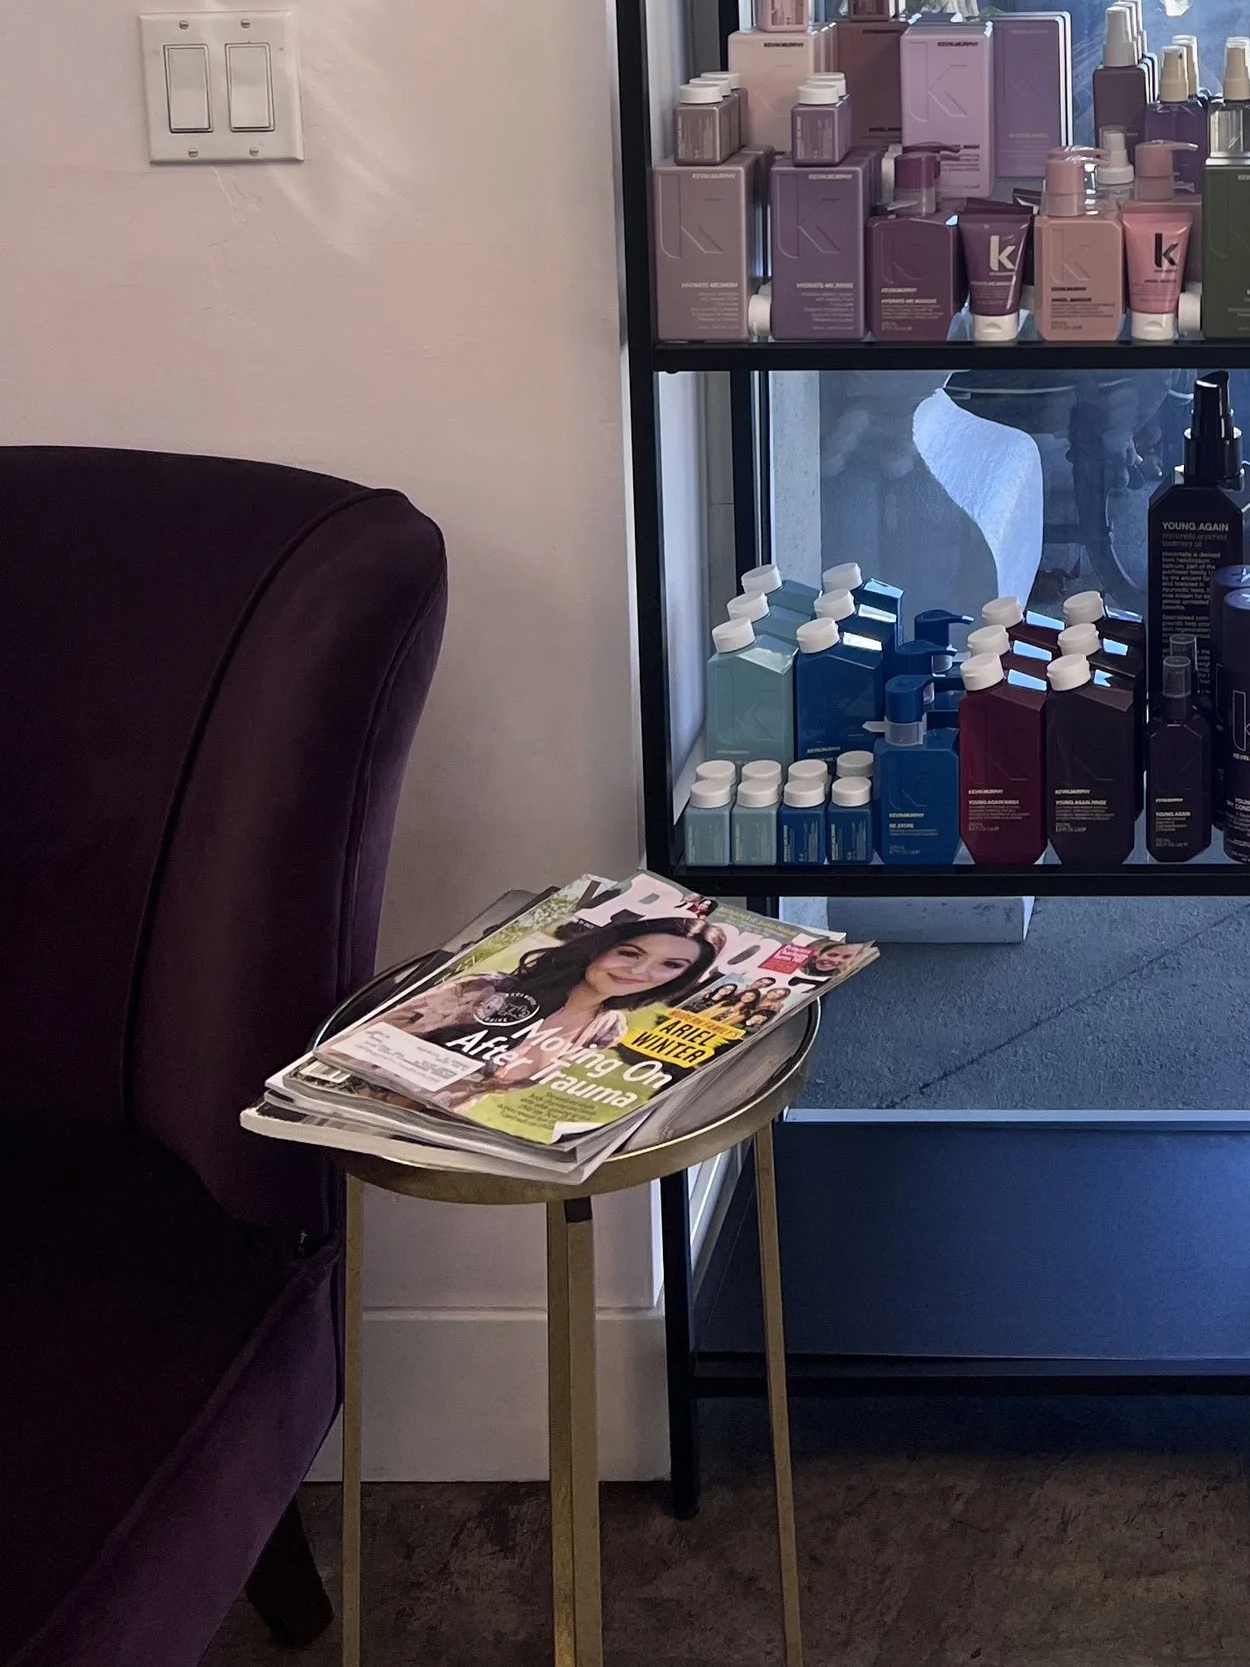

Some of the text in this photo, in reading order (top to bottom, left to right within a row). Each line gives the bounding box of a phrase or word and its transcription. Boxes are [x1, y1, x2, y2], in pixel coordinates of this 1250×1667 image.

[1162, 522, 1229, 531] YOUNG.AGAIN
[632, 1032, 705, 1062] WINTER
[660, 1020, 717, 1047] ARIEL
[446, 1030, 533, 1068] After
[529, 1059, 638, 1108] Trauma
[511, 1019, 623, 1078] Moving
[623, 1060, 672, 1089] On
